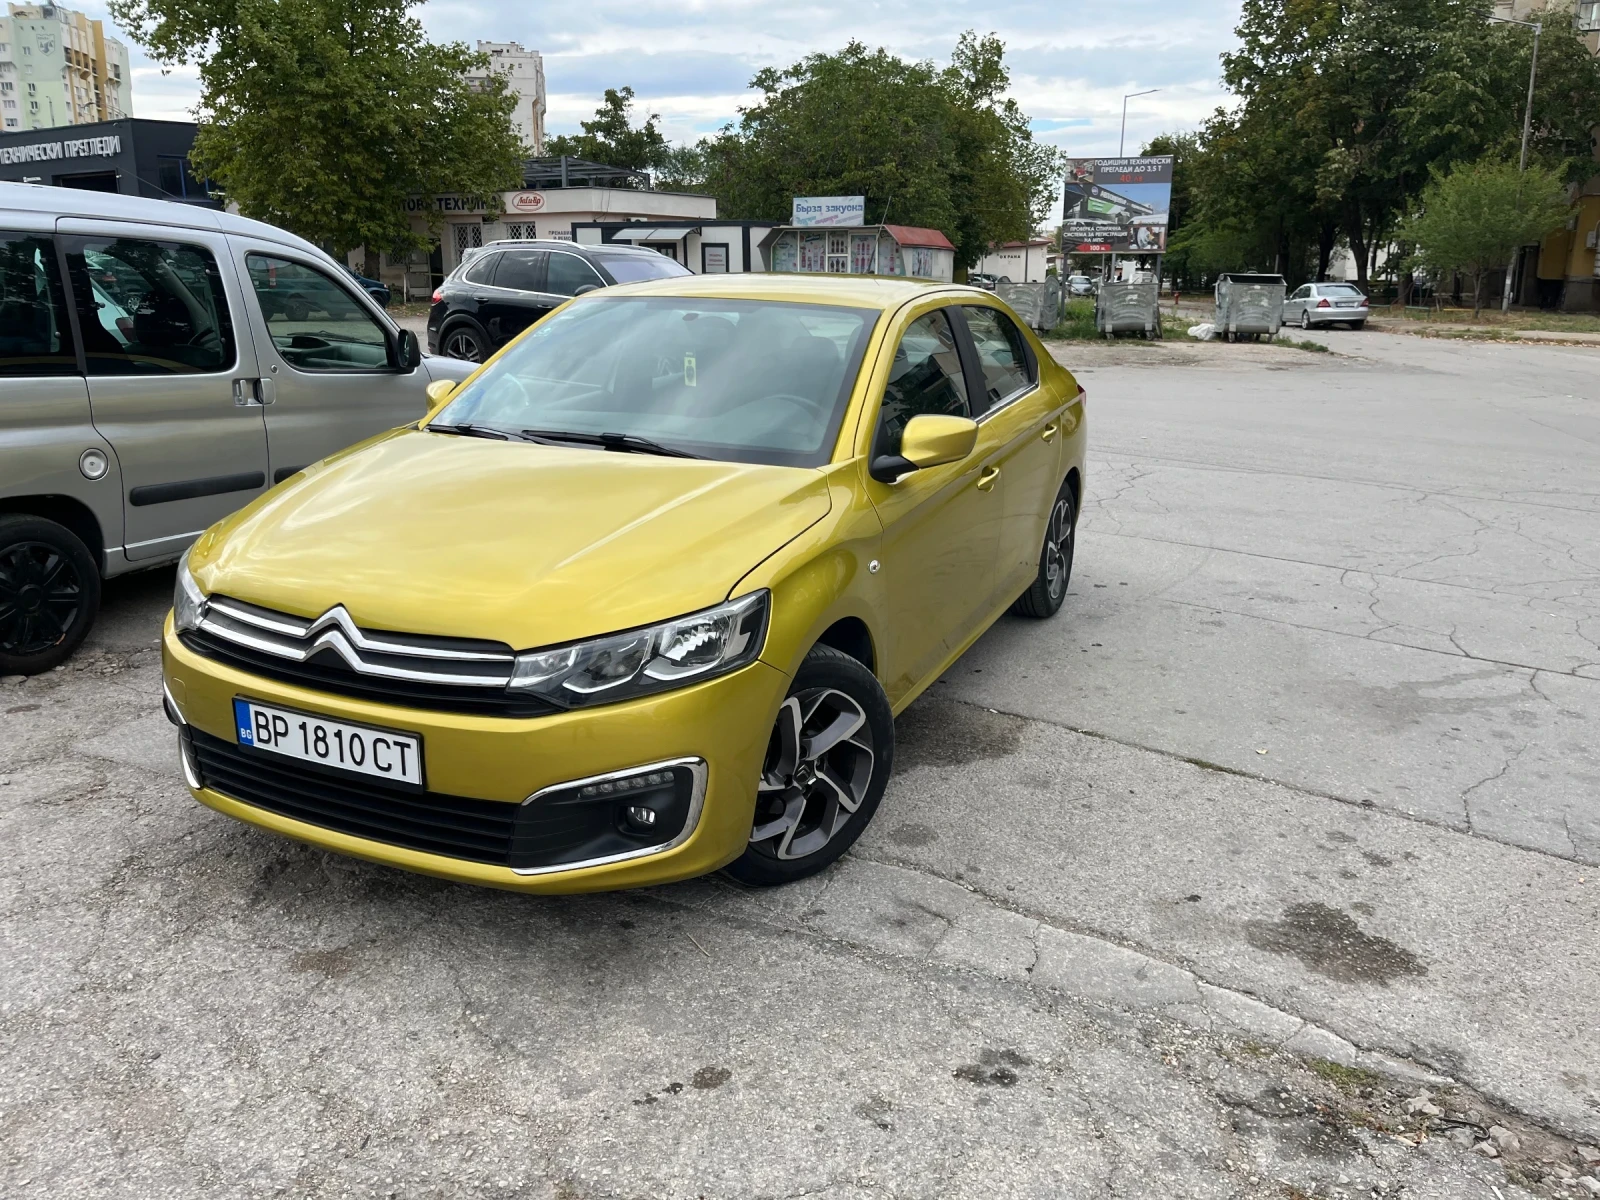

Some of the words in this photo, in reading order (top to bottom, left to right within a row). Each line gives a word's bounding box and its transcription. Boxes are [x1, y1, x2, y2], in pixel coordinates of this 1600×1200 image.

[0, 142, 62, 164] ТЕХНИЧЕСКИ
[64, 136, 121, 157] ПРЕГЛЕДИ
[796, 204, 822, 214] Бърза
[825, 205, 863, 214] закуска
[240, 728, 252, 739] BG
[254, 710, 288, 747] BP
[298, 721, 366, 766] 1810
[372, 737, 411, 776] CT
